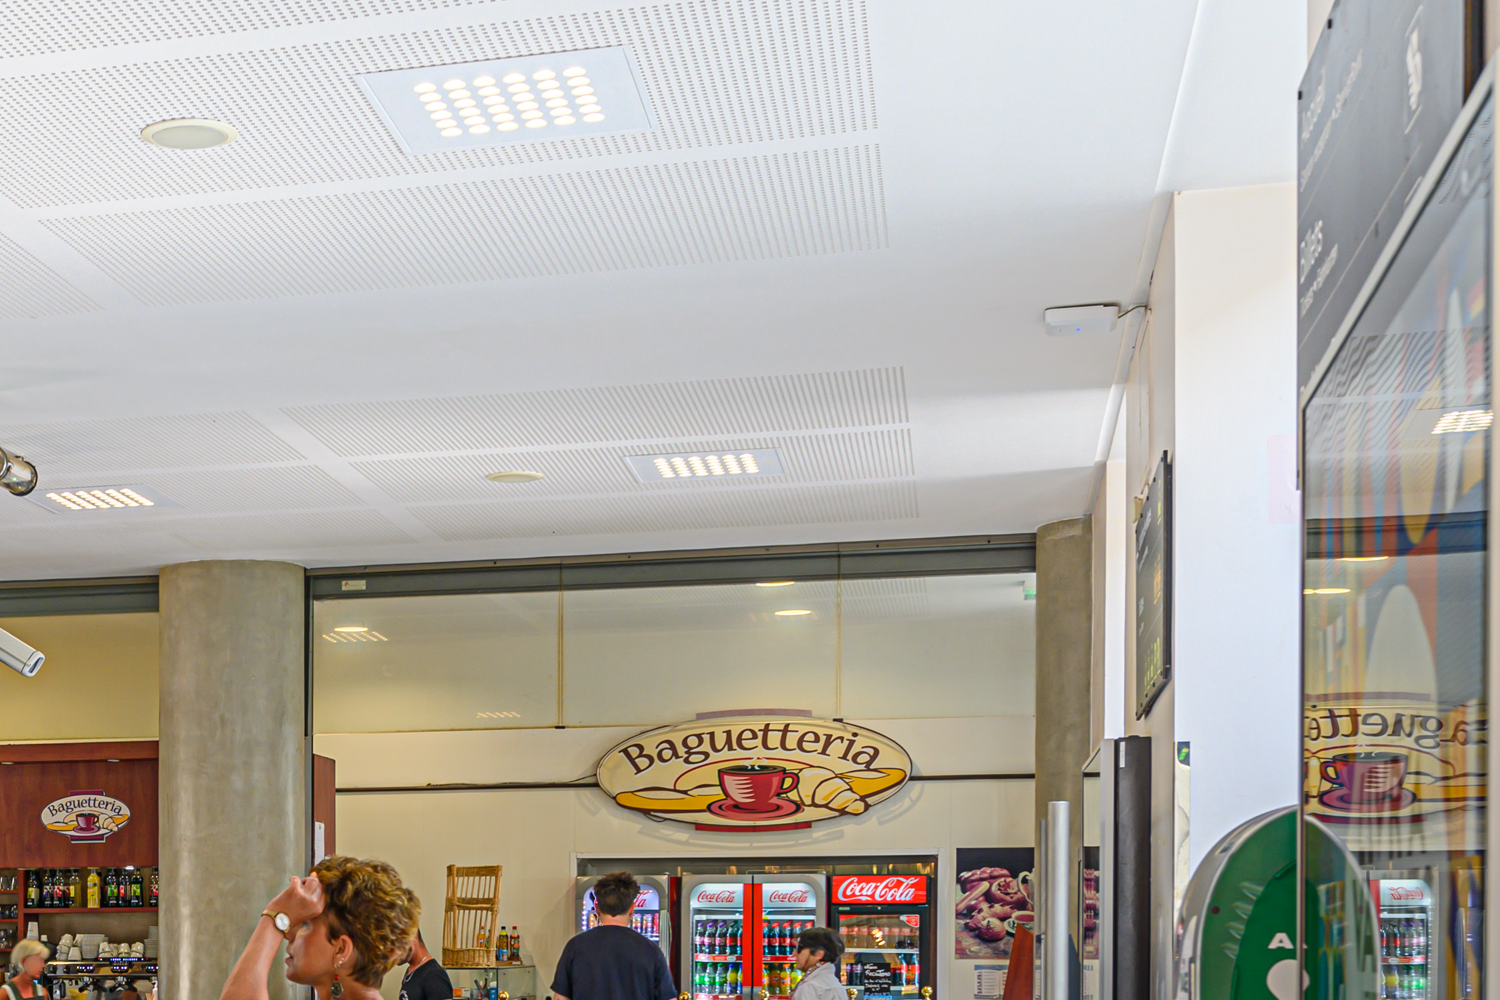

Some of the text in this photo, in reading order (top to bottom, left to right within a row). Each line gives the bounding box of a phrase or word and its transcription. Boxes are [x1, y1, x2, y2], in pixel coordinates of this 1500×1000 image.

[618, 723, 880, 775] Baguetteria
[48, 797, 122, 817] Baguetteria
[697, 890, 737, 903] Coca-Cola
[769, 890, 810, 903] Coca-Cola
[838, 877, 919, 901] Coca-Cola
